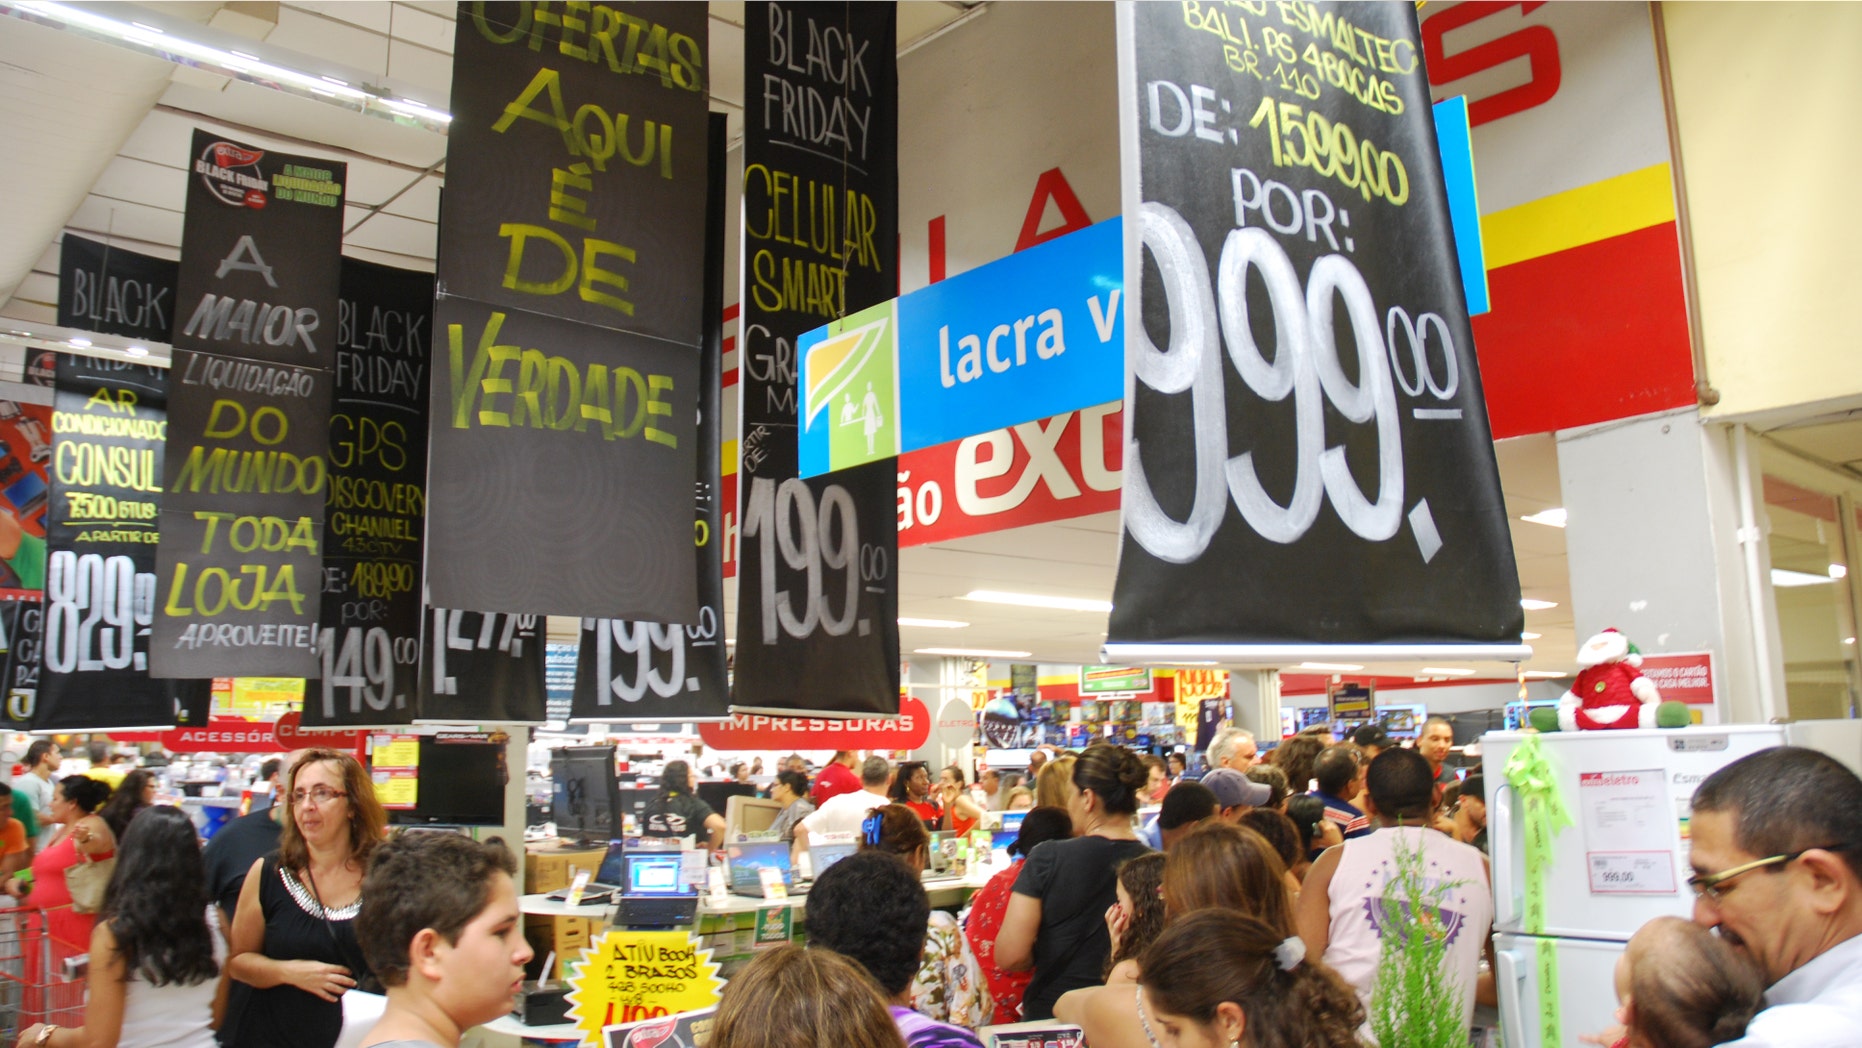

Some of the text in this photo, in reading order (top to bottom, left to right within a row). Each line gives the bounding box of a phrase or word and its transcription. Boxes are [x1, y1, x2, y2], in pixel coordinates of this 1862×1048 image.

[472, 0, 702, 92] OFERTAS
[768, 1, 872, 97] BLACK
[491, 67, 673, 180] AQUI
[763, 73, 871, 161] FRIDAY
[1147, 79, 1239, 145] DE:
[196, 160, 235, 183] BLACK
[548, 162, 597, 232] É
[745, 163, 881, 272] CELULAR
[1231, 167, 1354, 251] POR:
[215, 235, 279, 288] A
[498, 223, 637, 317] DE
[752, 250, 849, 319] SMART
[73, 269, 168, 330] BLACK
[184, 293, 319, 353] MAIOR
[337, 299, 424, 357] BLACK
[182, 352, 314, 398] LIQUIDAÇÃO
[337, 351, 423, 400] FRIDAY
[939, 307, 1065, 389] lacra
[84, 387, 138, 416] AR
[448, 311, 677, 450] VERDADE
[203, 400, 289, 445] DO
[328, 414, 406, 471] GPS
[55, 440, 164, 493] CONSUL
[171, 446, 327, 495] MUNDO
[194, 511, 319, 556] TODA
[331, 511, 418, 541] CHANNEL
[164, 562, 306, 617] LOJA
[341, 600, 388, 624] POR:
[174, 622, 319, 654] APROVEITE!
[719, 714, 914, 732] IMPRESSORAS
